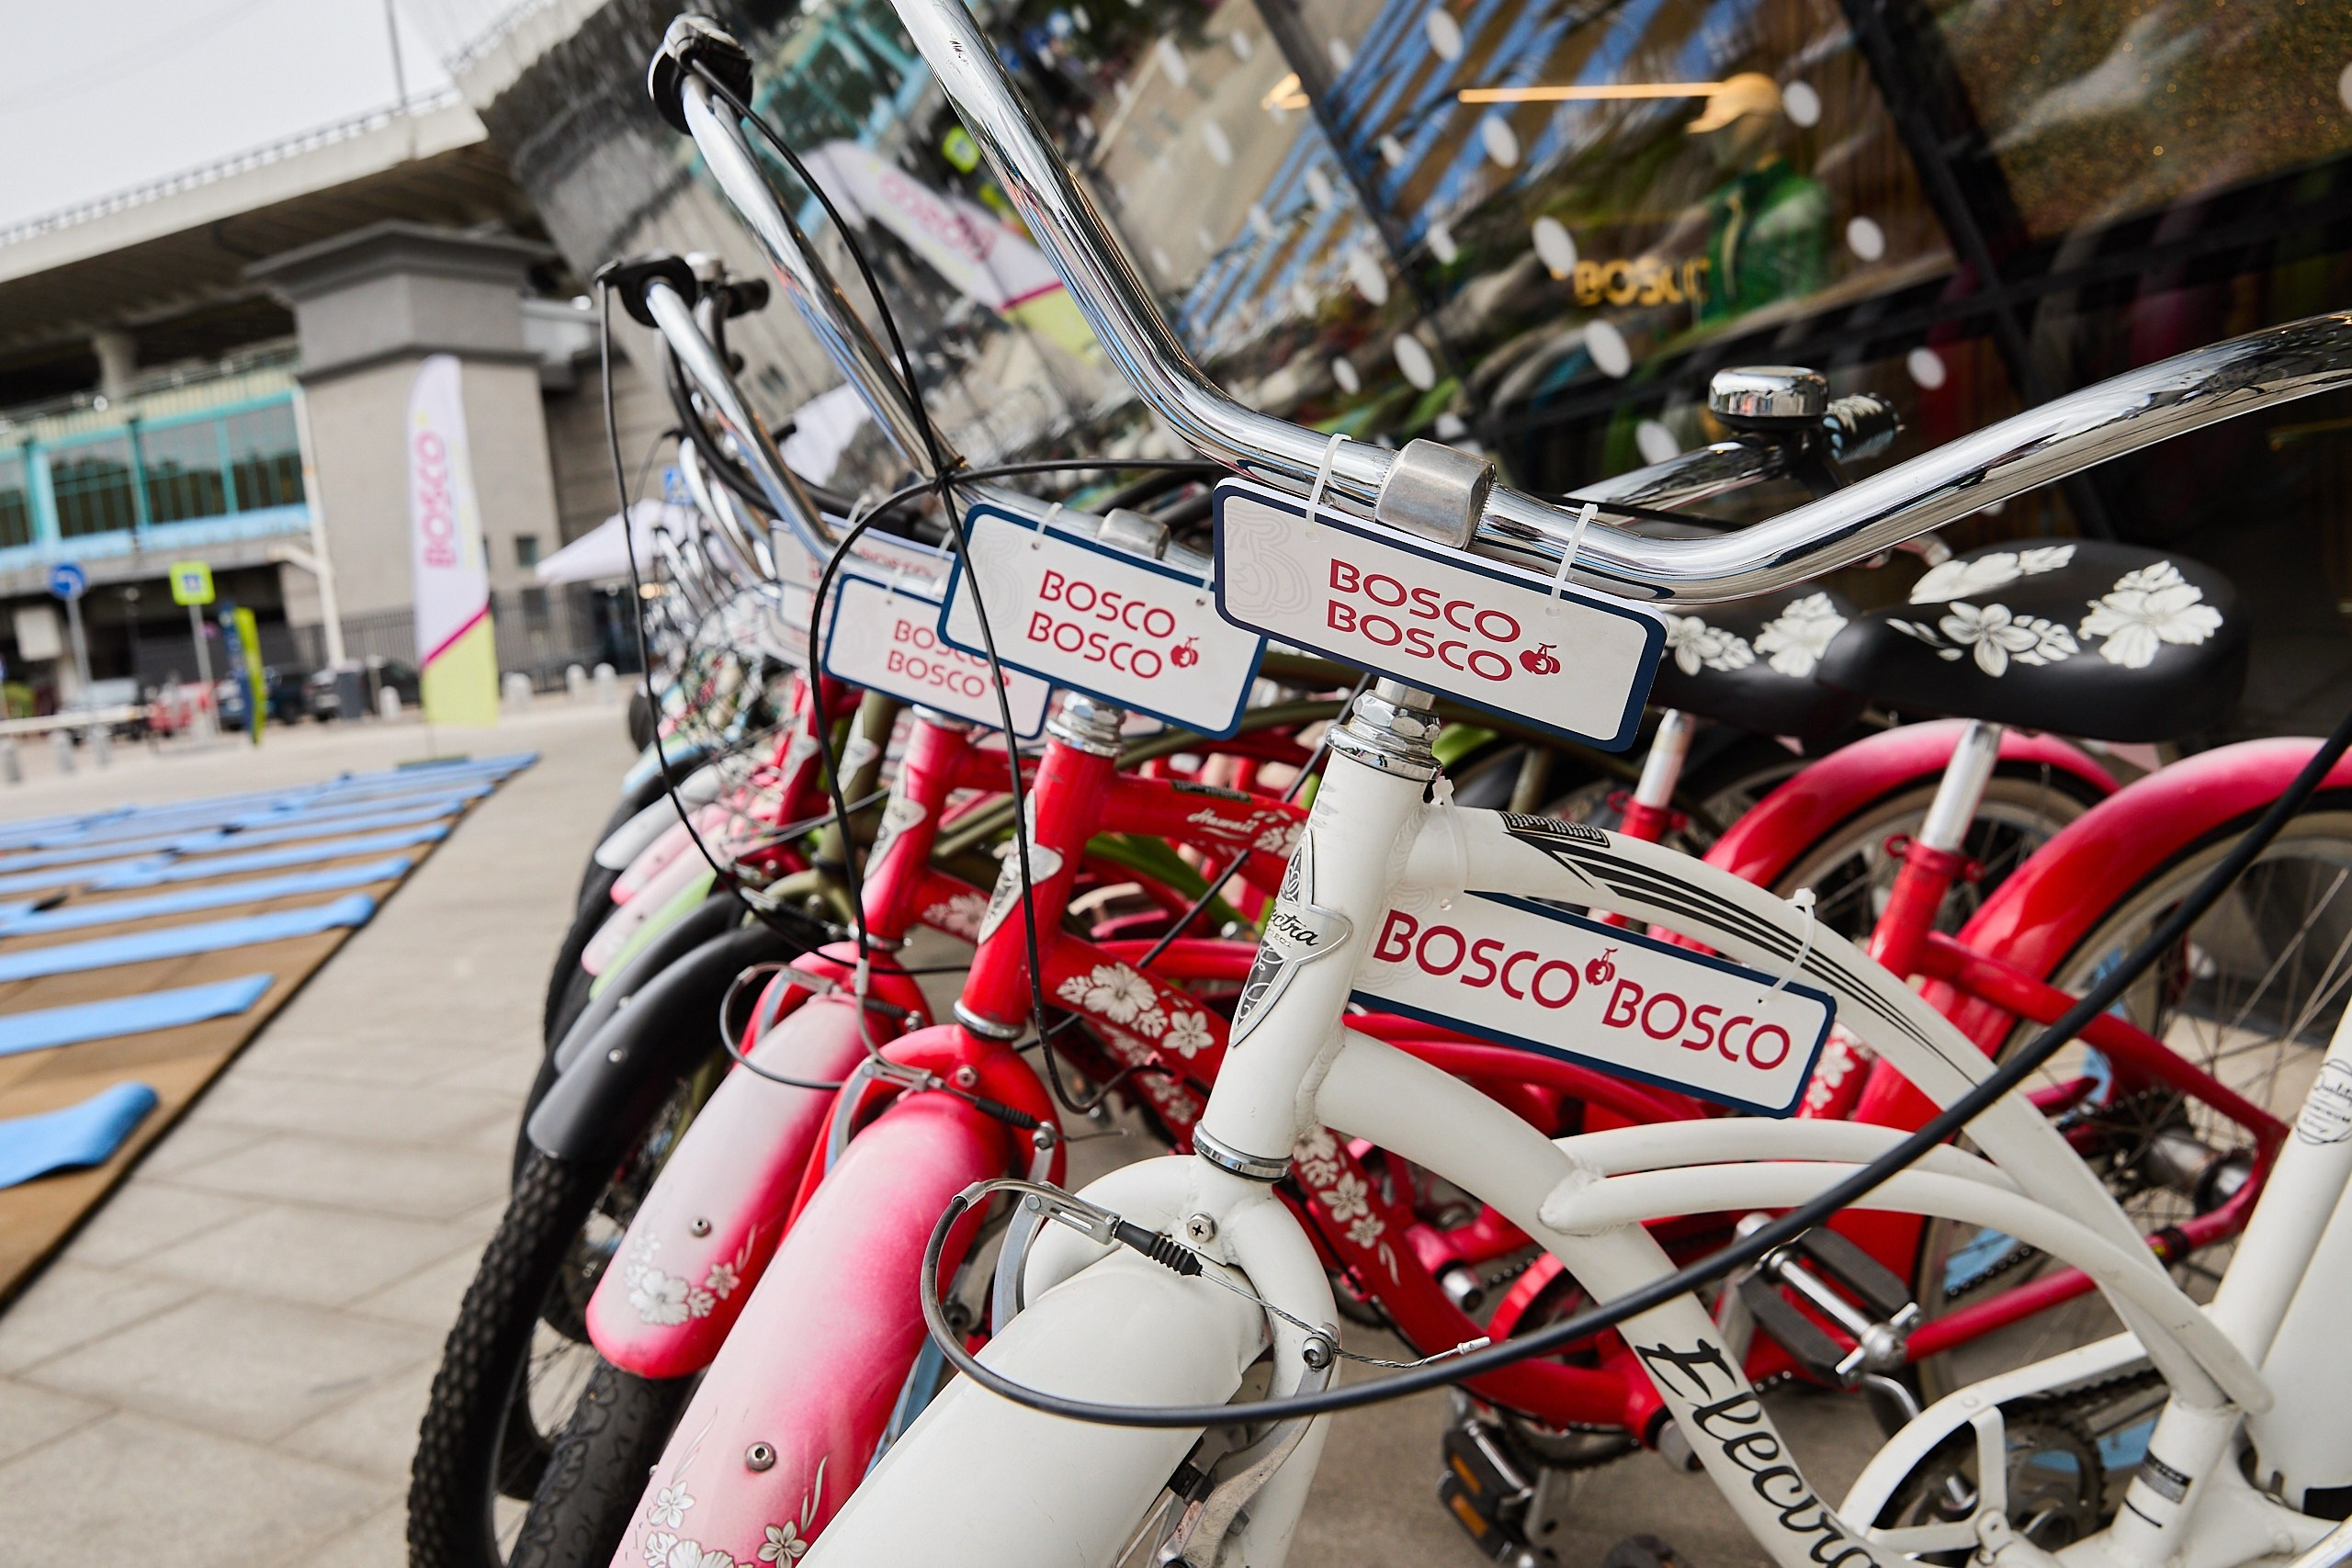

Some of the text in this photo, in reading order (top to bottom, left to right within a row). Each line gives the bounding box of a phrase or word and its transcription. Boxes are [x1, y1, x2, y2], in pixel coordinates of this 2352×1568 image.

[416, 431, 456, 568] BOSCO
[1038, 570, 1176, 639] BOSCO
[1326, 598, 1513, 682] BOSCO
[1329, 558, 1521, 643] BOSCO
[888, 649, 985, 697] BOSCO
[1026, 611, 1164, 680] BOSCO
[1374, 909, 1792, 1071] BOSCO BOSCO
